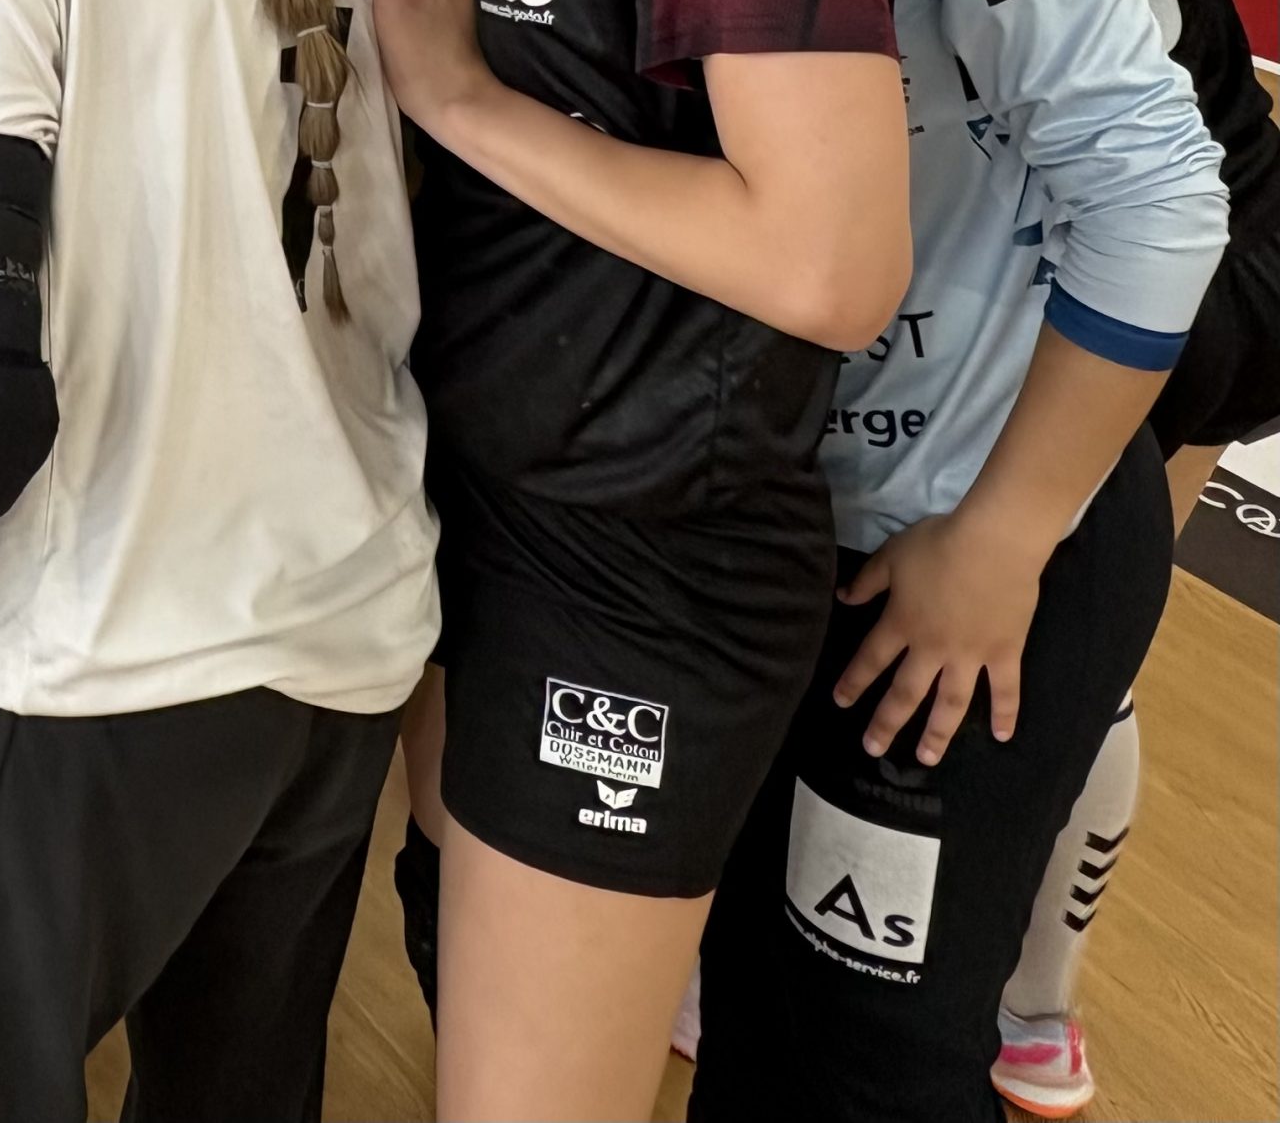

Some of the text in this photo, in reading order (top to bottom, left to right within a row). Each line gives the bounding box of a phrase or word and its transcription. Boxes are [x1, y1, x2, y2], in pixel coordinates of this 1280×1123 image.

[552, 688, 662, 743] C&C
[546, 720, 660, 762] Cuir et Coton
[549, 740, 652, 775] DOSSMANN
[578, 808, 648, 834] erima
